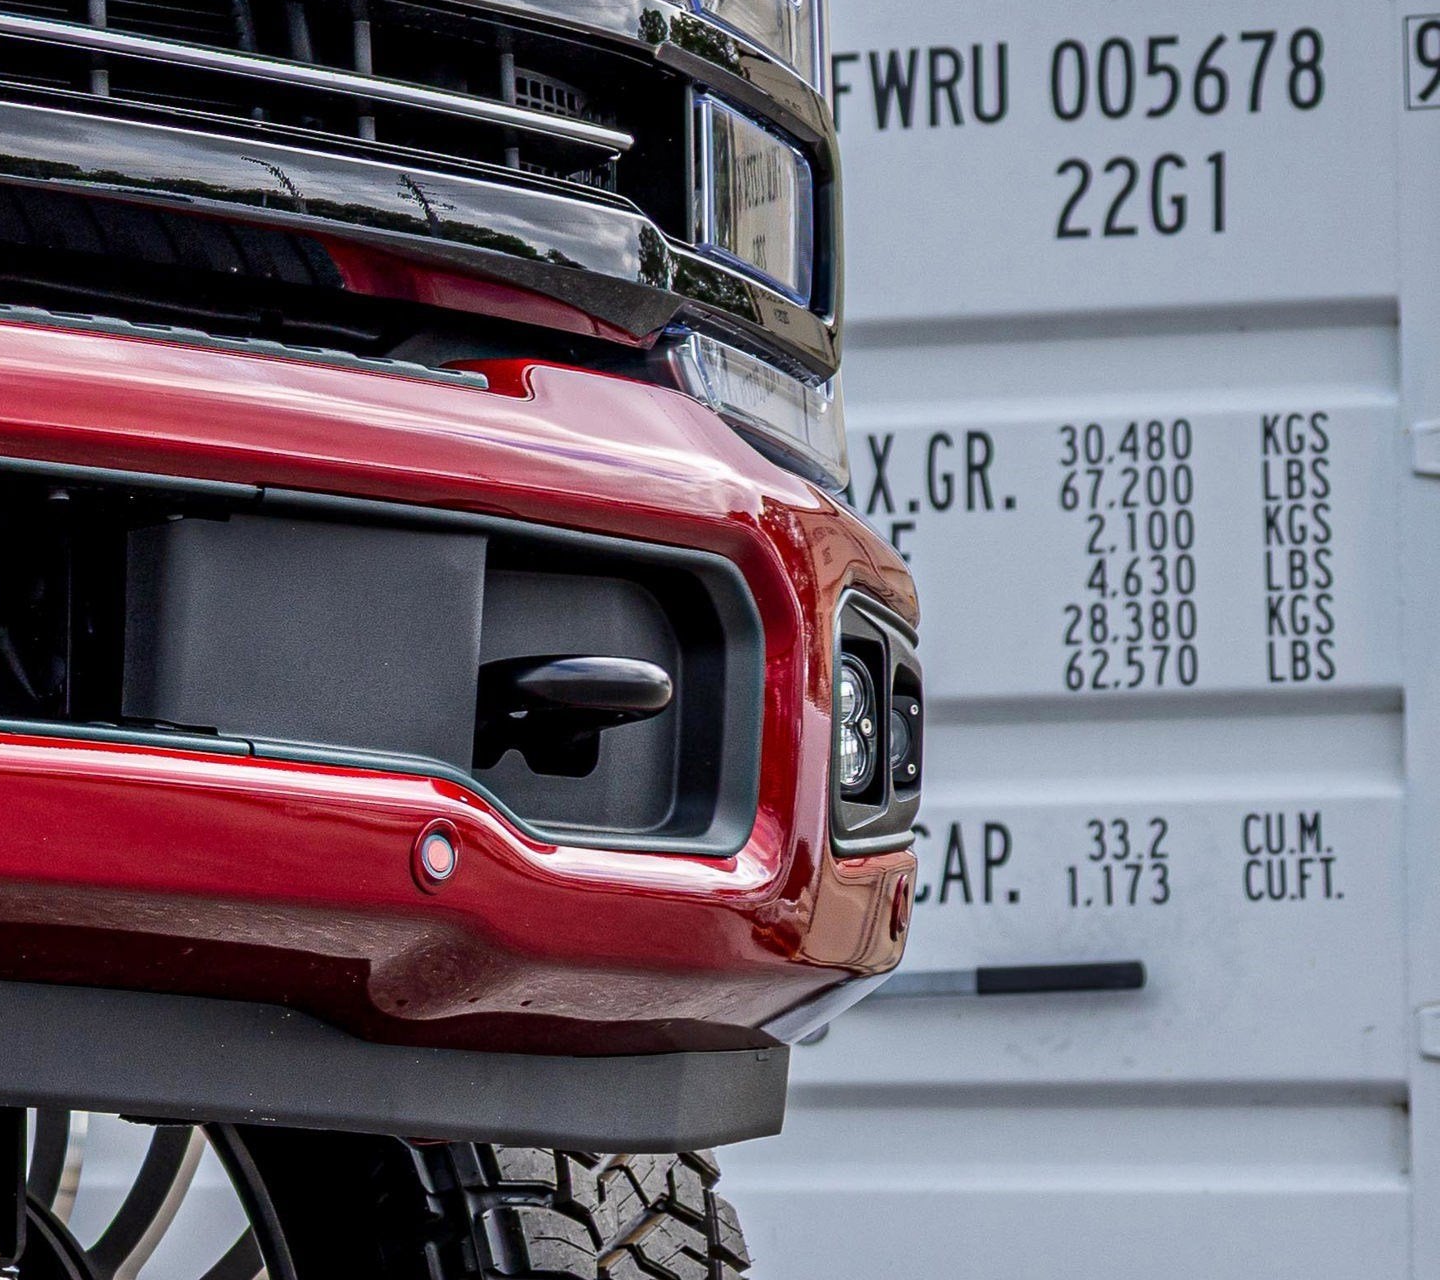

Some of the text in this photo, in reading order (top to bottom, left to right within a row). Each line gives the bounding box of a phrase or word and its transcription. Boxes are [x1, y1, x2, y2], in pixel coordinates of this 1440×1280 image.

[831, 41, 1009, 132] FWRU
[1049, 26, 1325, 122] 005678
[1055, 150, 1226, 240] 22G1
[1059, 419, 1192, 466] 30.480
[1261, 411, 1330, 456] KGS
[1059, 456, 1331, 511] 67.200 LBS
[1086, 501, 1333, 556] 2.100 KGS
[1085, 546, 1334, 600] 4.630 LBS
[1063, 592, 1336, 646] 28.380 KGS
[1065, 637, 1337, 691] 62.570 LBS
[1086, 817, 1169, 863] 33.2
[1242, 811, 1333, 857] CU.M.
[1066, 856, 1345, 907] 1.173 CU.FT.
